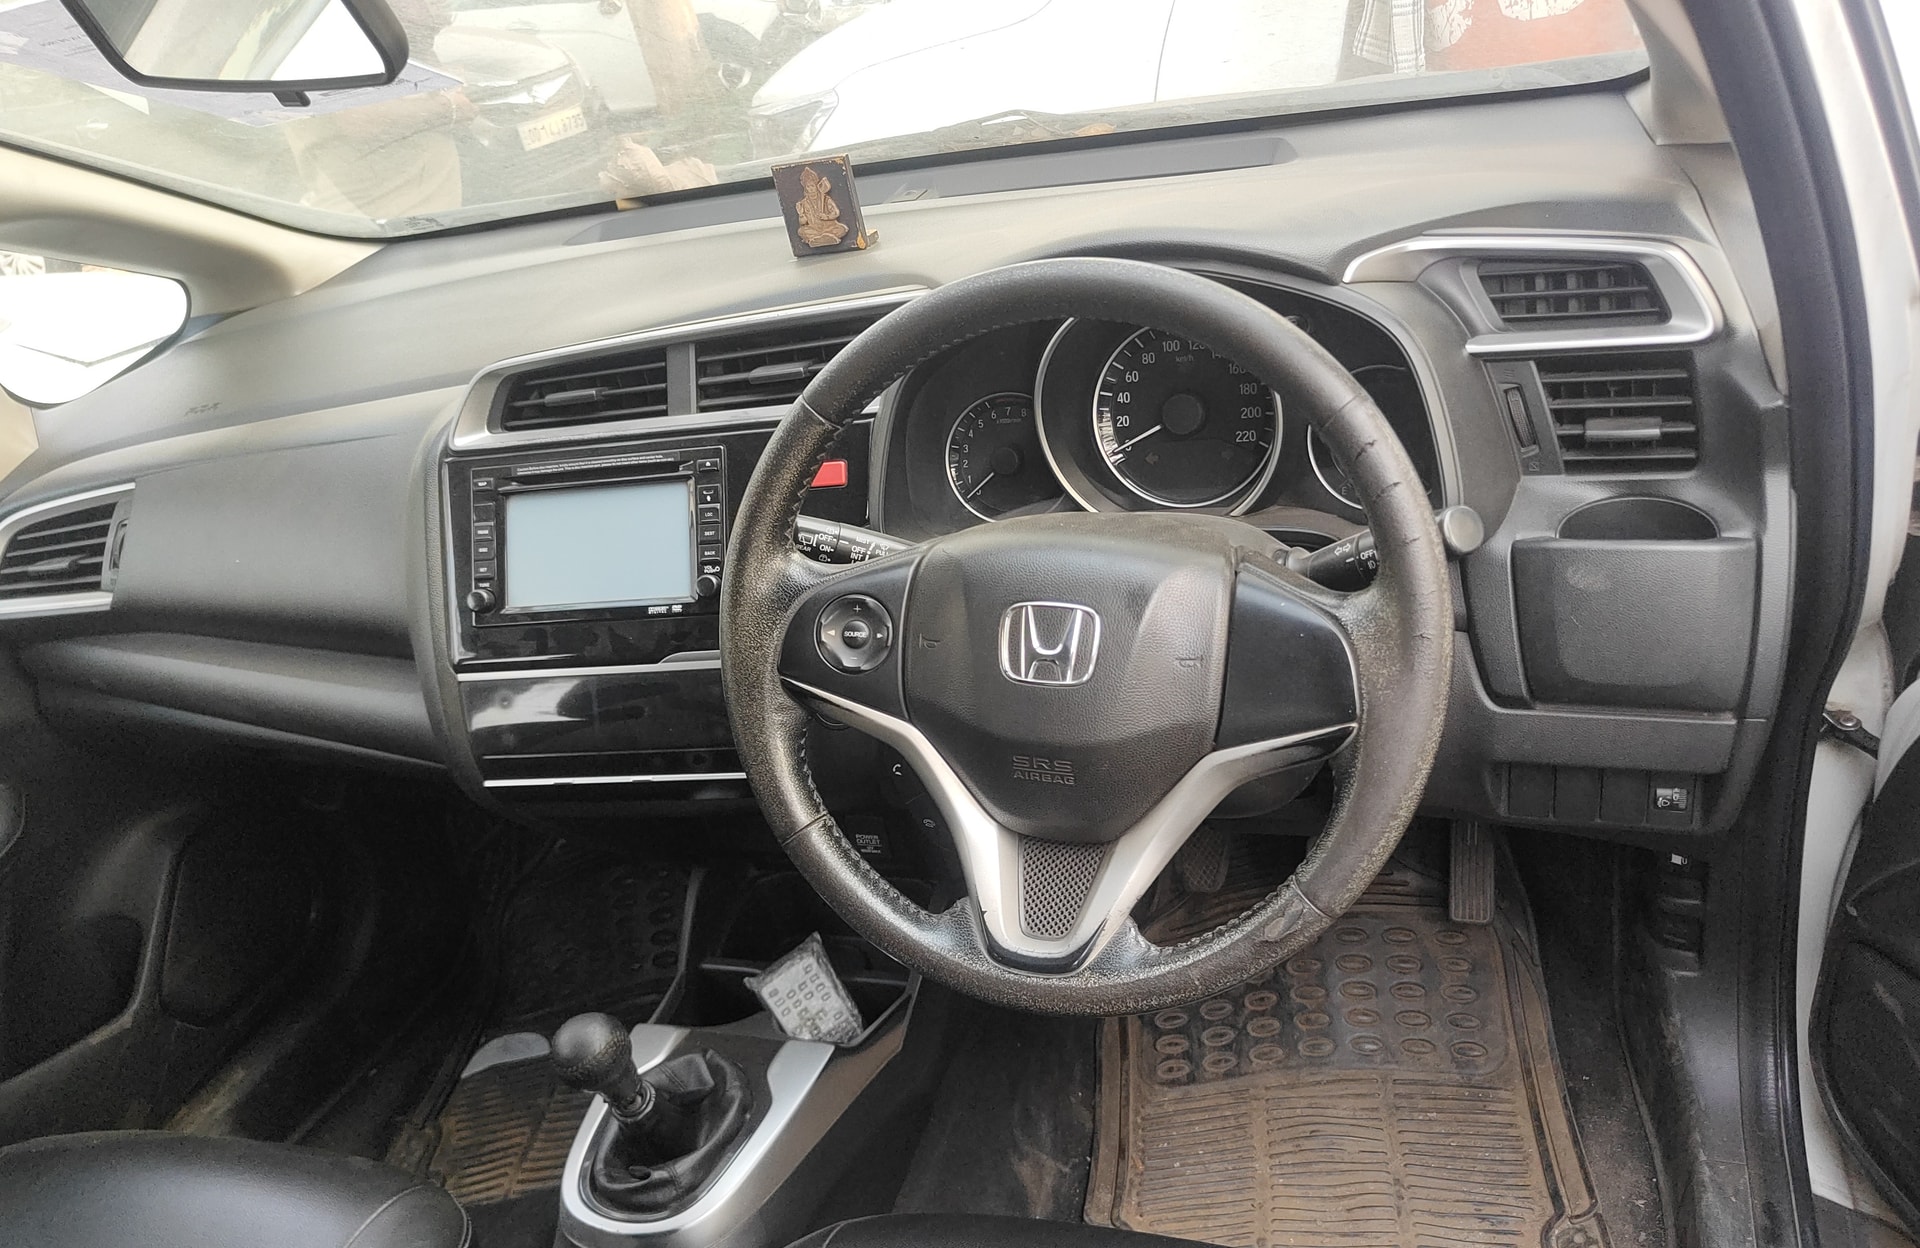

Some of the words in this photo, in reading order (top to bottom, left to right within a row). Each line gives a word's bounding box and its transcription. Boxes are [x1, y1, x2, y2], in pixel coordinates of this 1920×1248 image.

[1162, 340, 1181, 352] 100
[1141, 352, 1156, 364] 80
[1175, 354, 1194, 362] km/h
[1125, 370, 1139, 383] 60
[1239, 382, 1258, 395] 180
[1117, 392, 1131, 403] 40
[991, 410, 997, 419] 6
[1005, 407, 1011, 416] 7
[1021, 408, 1027, 417] 8
[1240, 406, 1262, 419] 200
[978, 420, 984, 428] 5
[1116, 415, 1130, 427] 20
[968, 429, 974, 438] 4
[1235, 430, 1257, 443] 220
[963, 444, 969, 453] 3
[963, 460, 969, 468] 2
[968, 475, 972, 484] 1
[1341, 486, 1347, 495] E
[818, 533, 833, 542] OFF
[819, 544, 830, 552] ON
[851, 545, 866, 554] OFF
[850, 552, 863, 560] INT
[1360, 549, 1374, 560] OFF
[1013, 755, 1073, 772] SRS
[1013, 771, 1075, 785] AIRBAG
